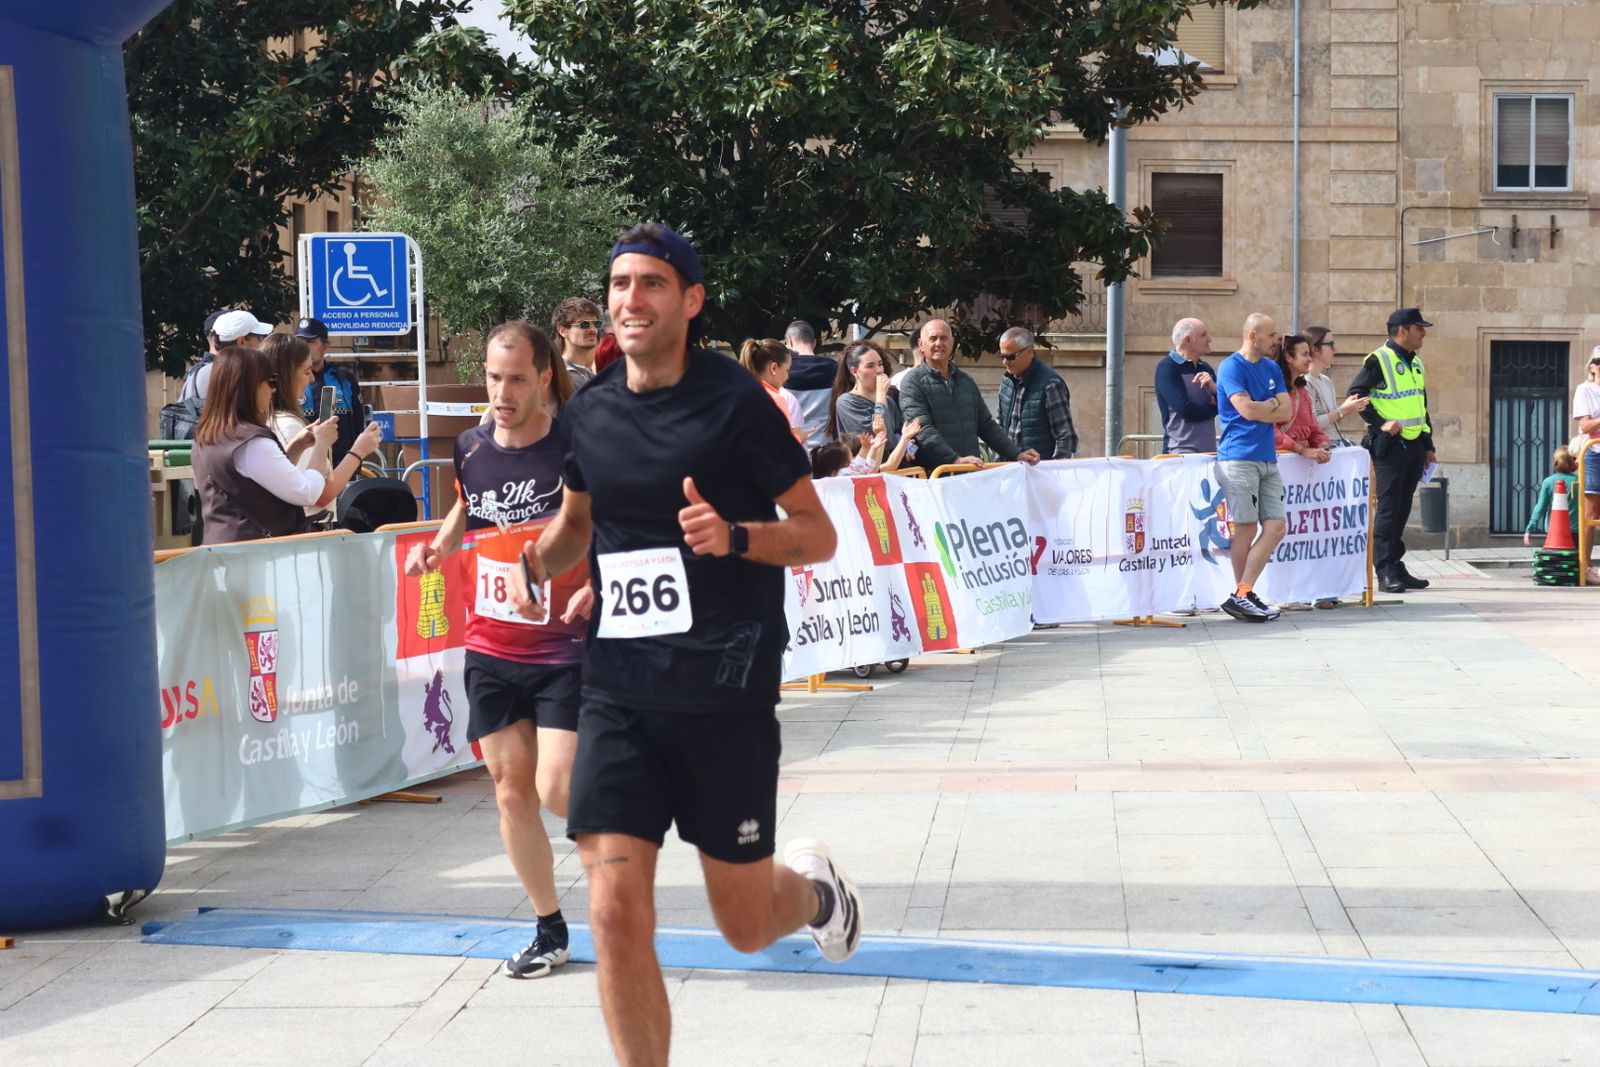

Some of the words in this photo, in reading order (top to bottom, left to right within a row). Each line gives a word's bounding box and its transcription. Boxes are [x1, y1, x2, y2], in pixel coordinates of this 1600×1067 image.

[1282, 477, 1346, 505] ERACIÓN
[1353, 476, 1369, 498] DE
[1286, 503, 1367, 535] LETISMO
[946, 517, 1028, 561] Plena
[1149, 536, 1180, 551] unta
[1052, 549, 1092, 564] VAORES
[1119, 556, 1156, 572] Castila
[1158, 557, 1166, 573] y
[610, 574, 680, 616] 266
[812, 574, 853, 603] Junta
[857, 570, 873, 597] de
[786, 614, 834, 652] stilla
[836, 617, 844, 646] y
[847, 606, 880, 636] León
[283, 684, 334, 716] Junta
[337, 675, 359, 705] de
[301, 731, 311, 763] y
[316, 715, 359, 751] León
